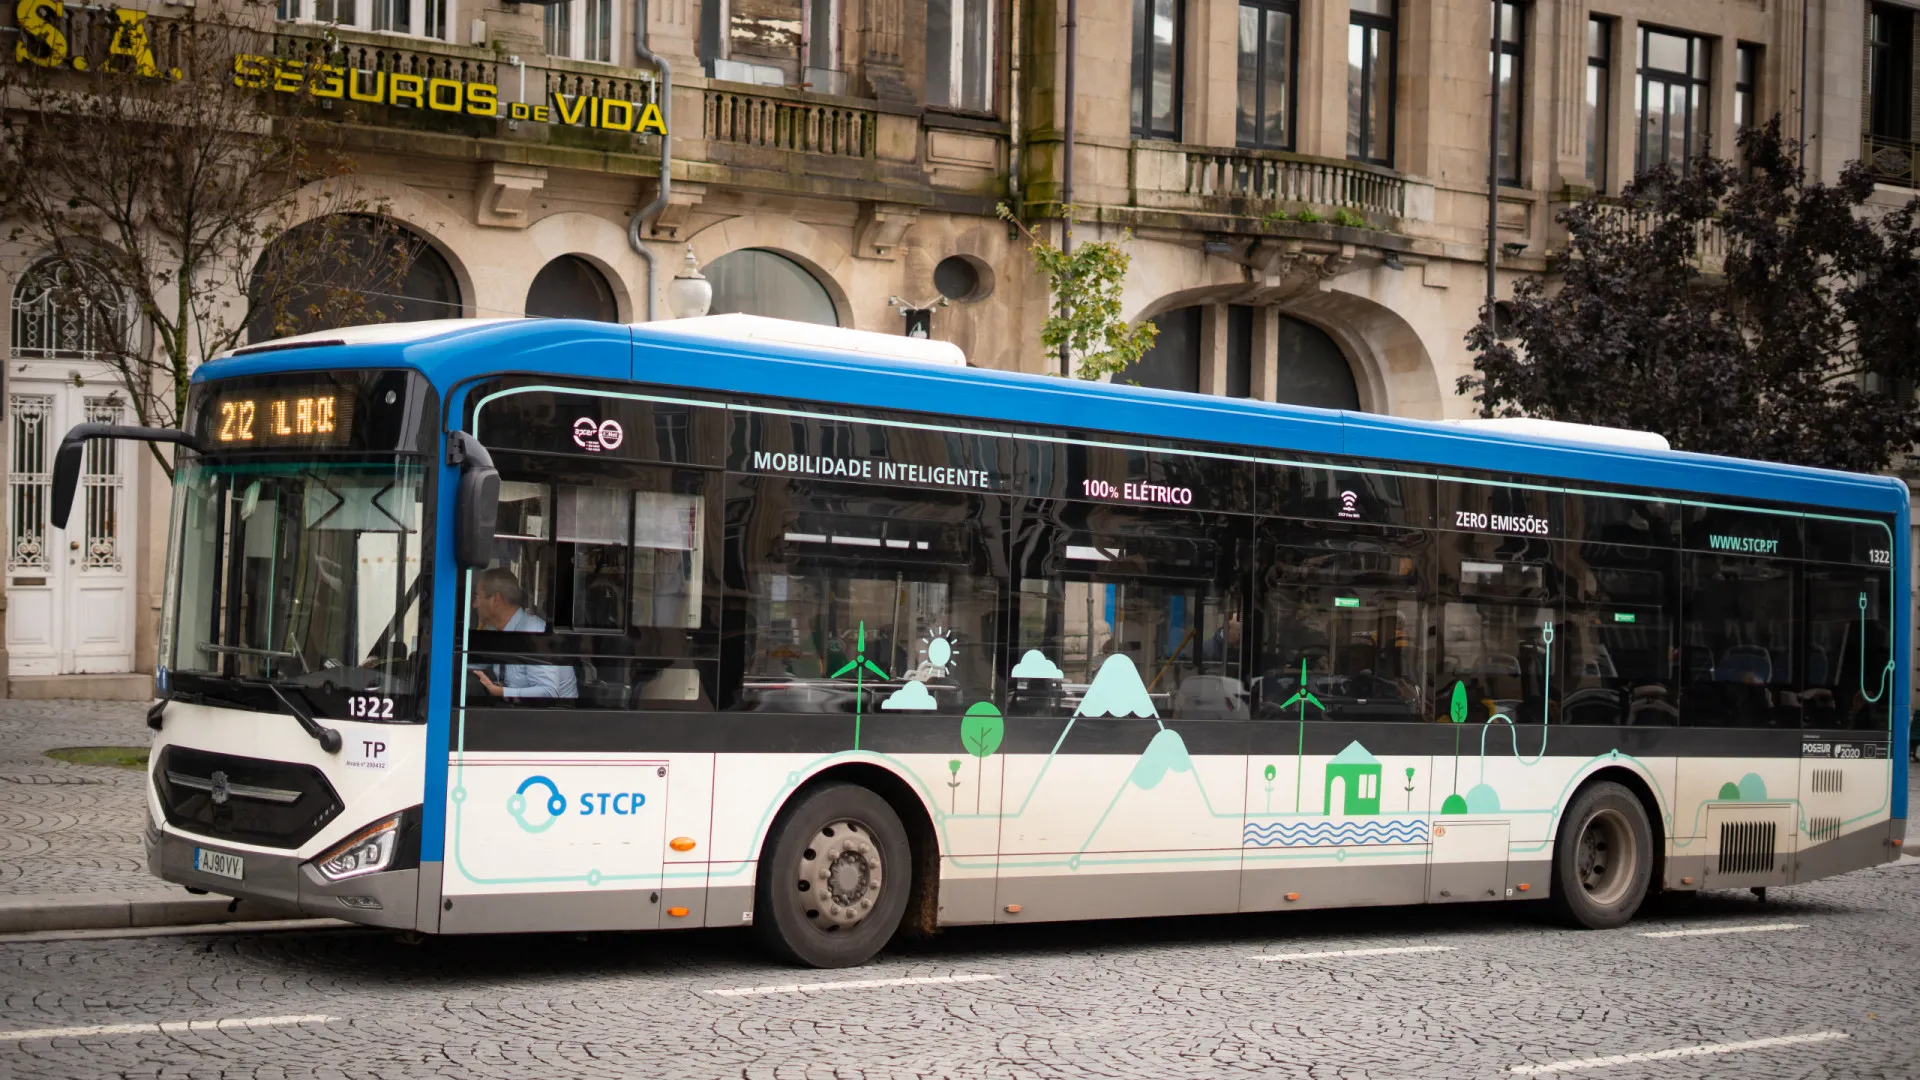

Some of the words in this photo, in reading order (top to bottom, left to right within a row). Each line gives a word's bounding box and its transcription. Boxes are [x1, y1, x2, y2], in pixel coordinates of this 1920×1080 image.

[234, 53, 498, 116] SEGUROS
[511, 102, 549, 122] DE
[553, 92, 669, 135] VIDA
[754, 451, 872, 478] MOBILIDADE
[878, 461, 989, 488] INTELIGENTE
[1083, 479, 1119, 499] 100%
[1124, 481, 1192, 505] ELÉTRICO
[1456, 511, 1488, 529] ZERO
[1491, 514, 1549, 534] EMISSÕES
[1709, 534, 1779, 553] WWW.STCP.PT
[1869, 549, 1890, 564] 1322
[348, 696, 394, 718] 1322
[363, 740, 386, 758] TP
[1841, 748, 1861, 758] 2020
[579, 792, 646, 815] STCP
